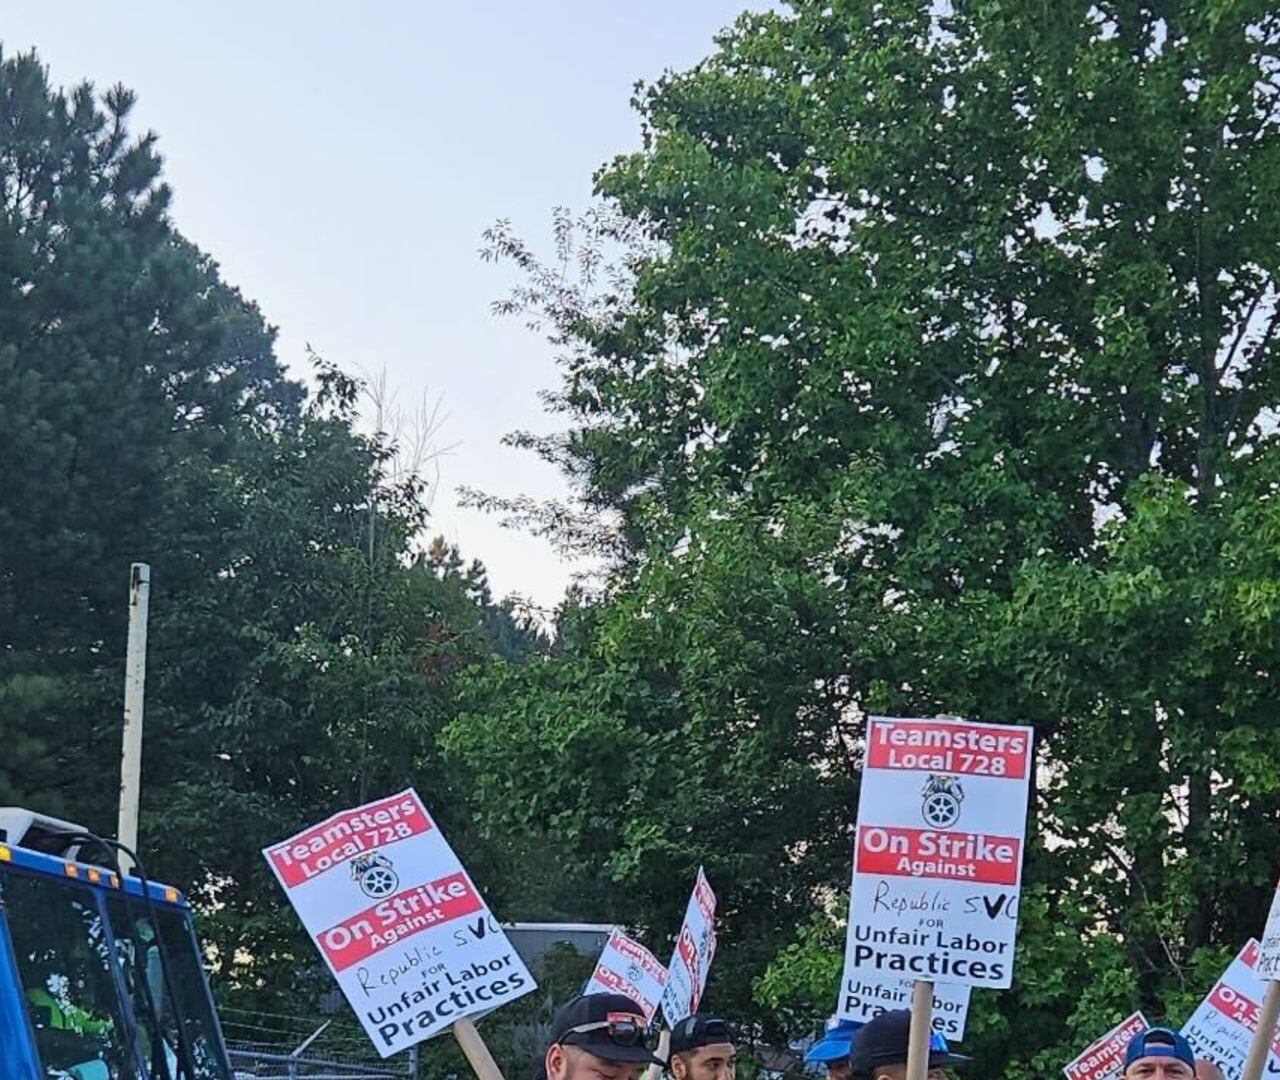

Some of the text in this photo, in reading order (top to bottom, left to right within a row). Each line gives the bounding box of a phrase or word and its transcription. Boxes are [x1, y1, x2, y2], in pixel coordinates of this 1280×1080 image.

[875, 722, 1025, 754] Teamsters
[889, 749, 1006, 775] Local 728
[273, 800, 416, 867] Teamsters
[300, 822, 413, 879] Local 728
[864, 828, 1013, 863] On Strike
[897, 857, 976, 877] Against
[325, 881, 468, 951] On Strike
[873, 880, 951, 917] Republic
[371, 907, 445, 949] Against
[855, 925, 1008, 954] Unfair Labor
[919, 918, 944, 928] FOR
[356, 944, 443, 997] Republic
[421, 962, 447, 979] FOR
[599, 967, 617, 985] On
[855, 945, 1004, 981] Practices
[367, 953, 513, 1026] Unfair Labor
[848, 979, 907, 1001] Unfair
[1219, 987, 1248, 1011] On
[378, 971, 526, 1047] Practices
[1070, 1019, 1144, 1077] Teamsters
[1190, 1025, 1237, 1060] Unfair
